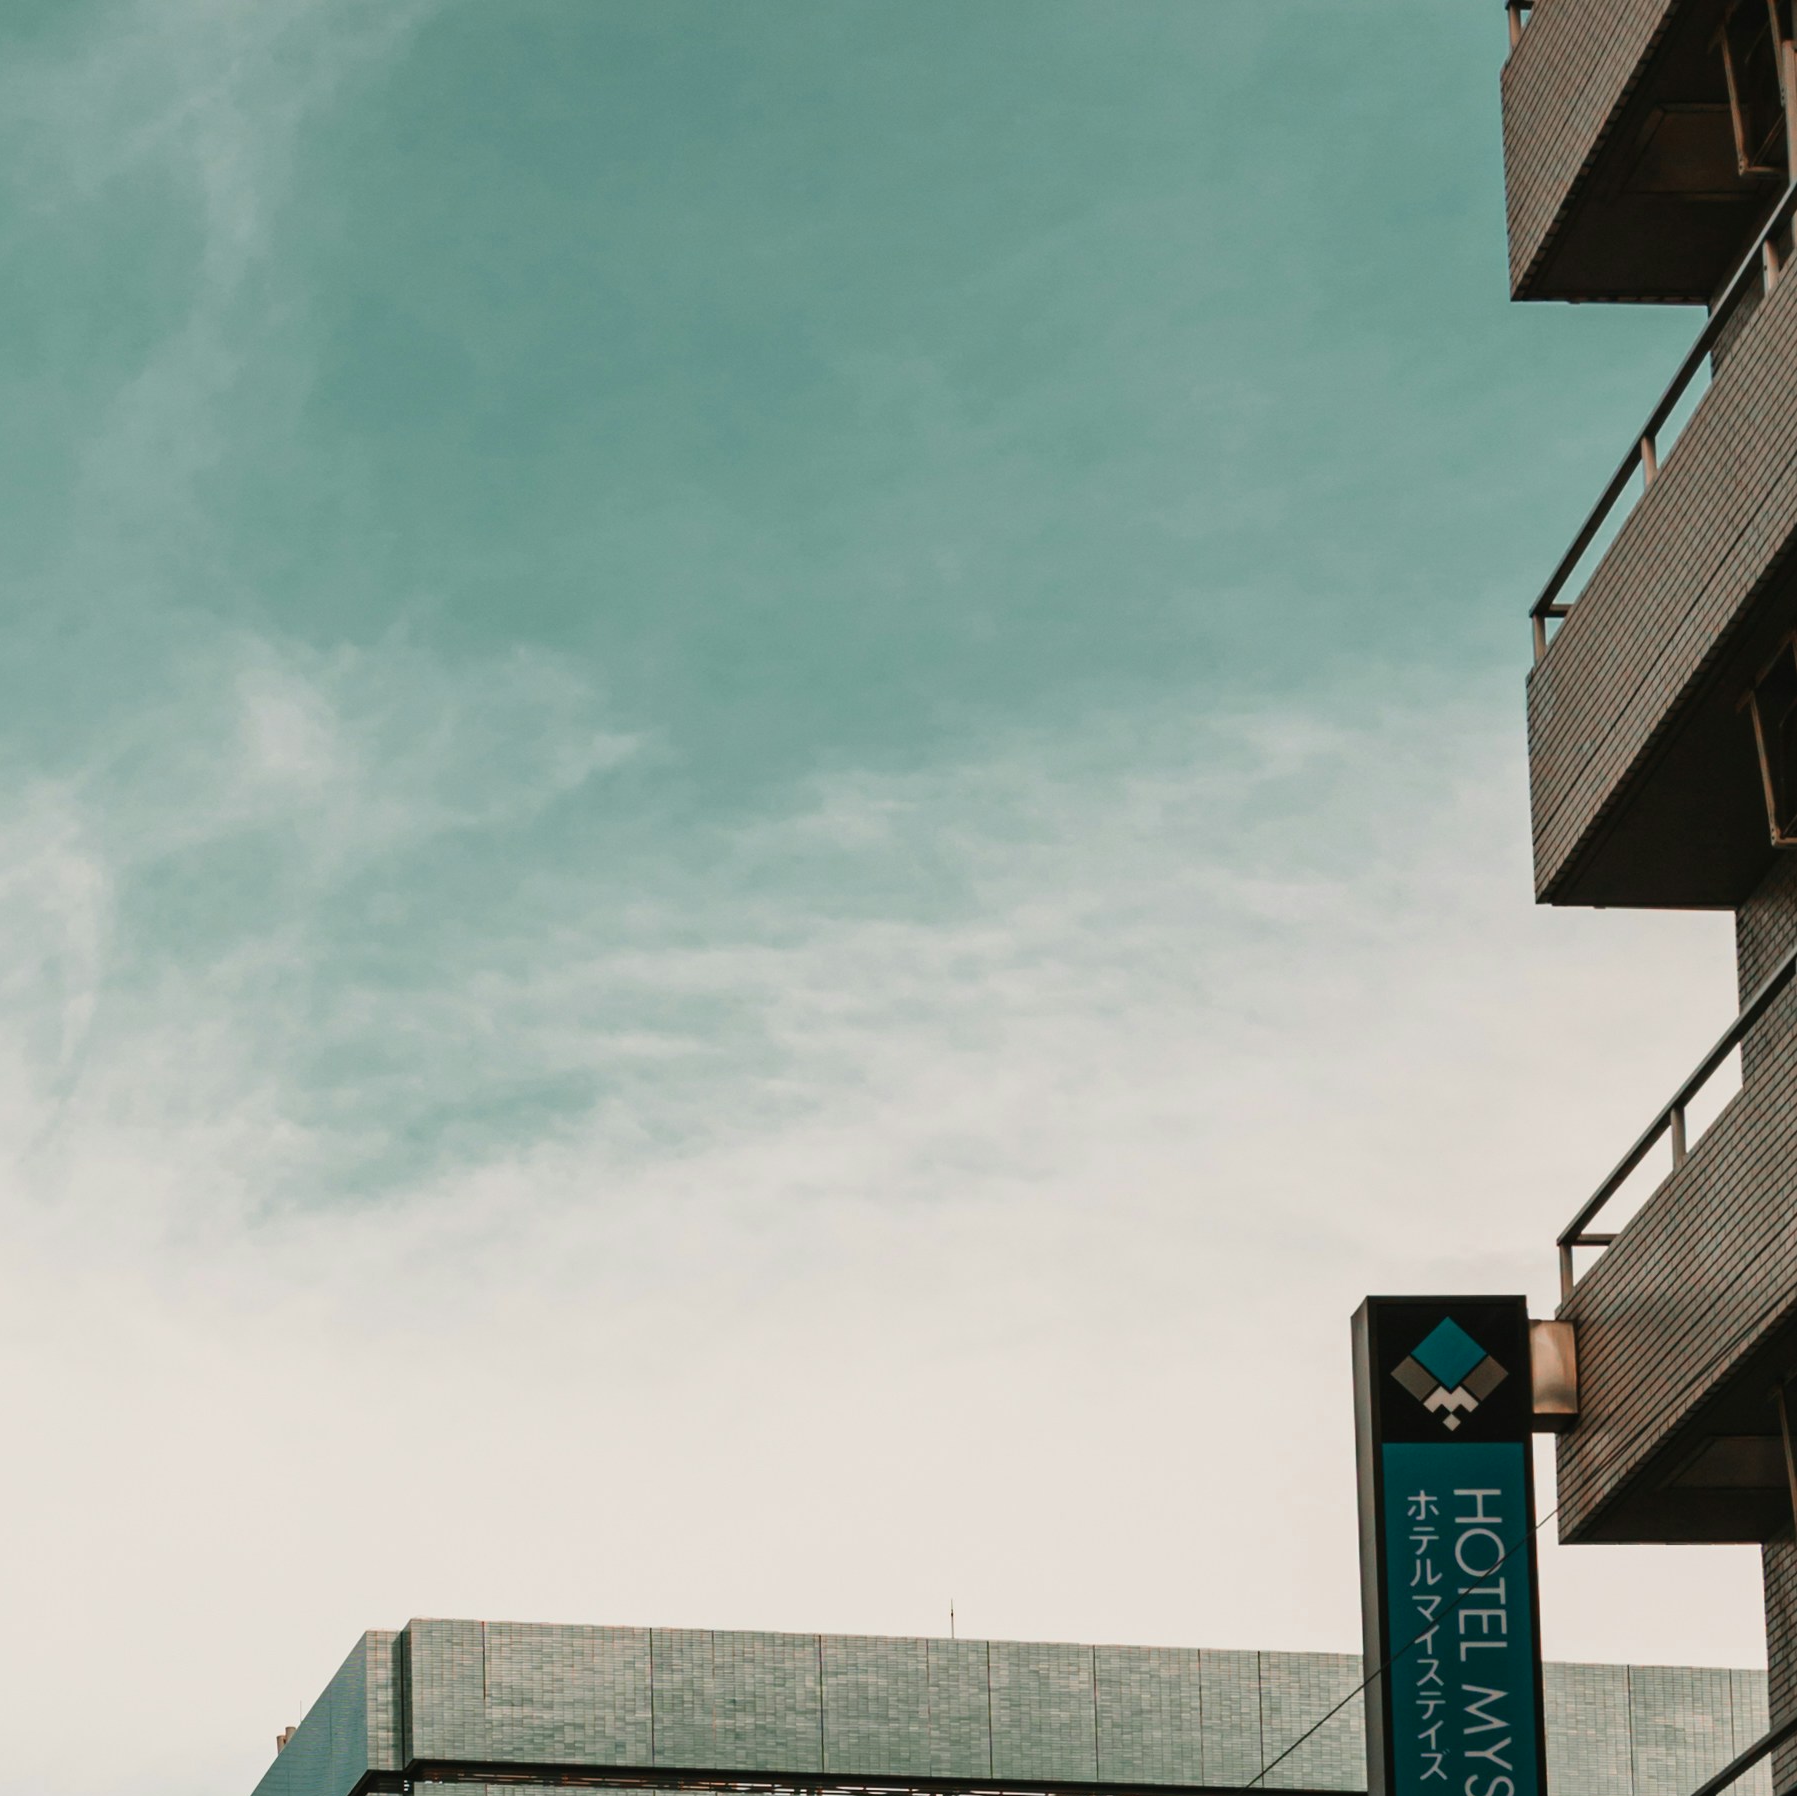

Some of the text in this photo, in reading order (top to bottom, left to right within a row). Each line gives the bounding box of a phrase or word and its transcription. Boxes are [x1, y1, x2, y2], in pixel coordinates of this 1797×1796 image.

[1407, 1489, 1451, 1781] ホテルマイステイズ
[1453, 1488, 1508, 1662] HOTEL
